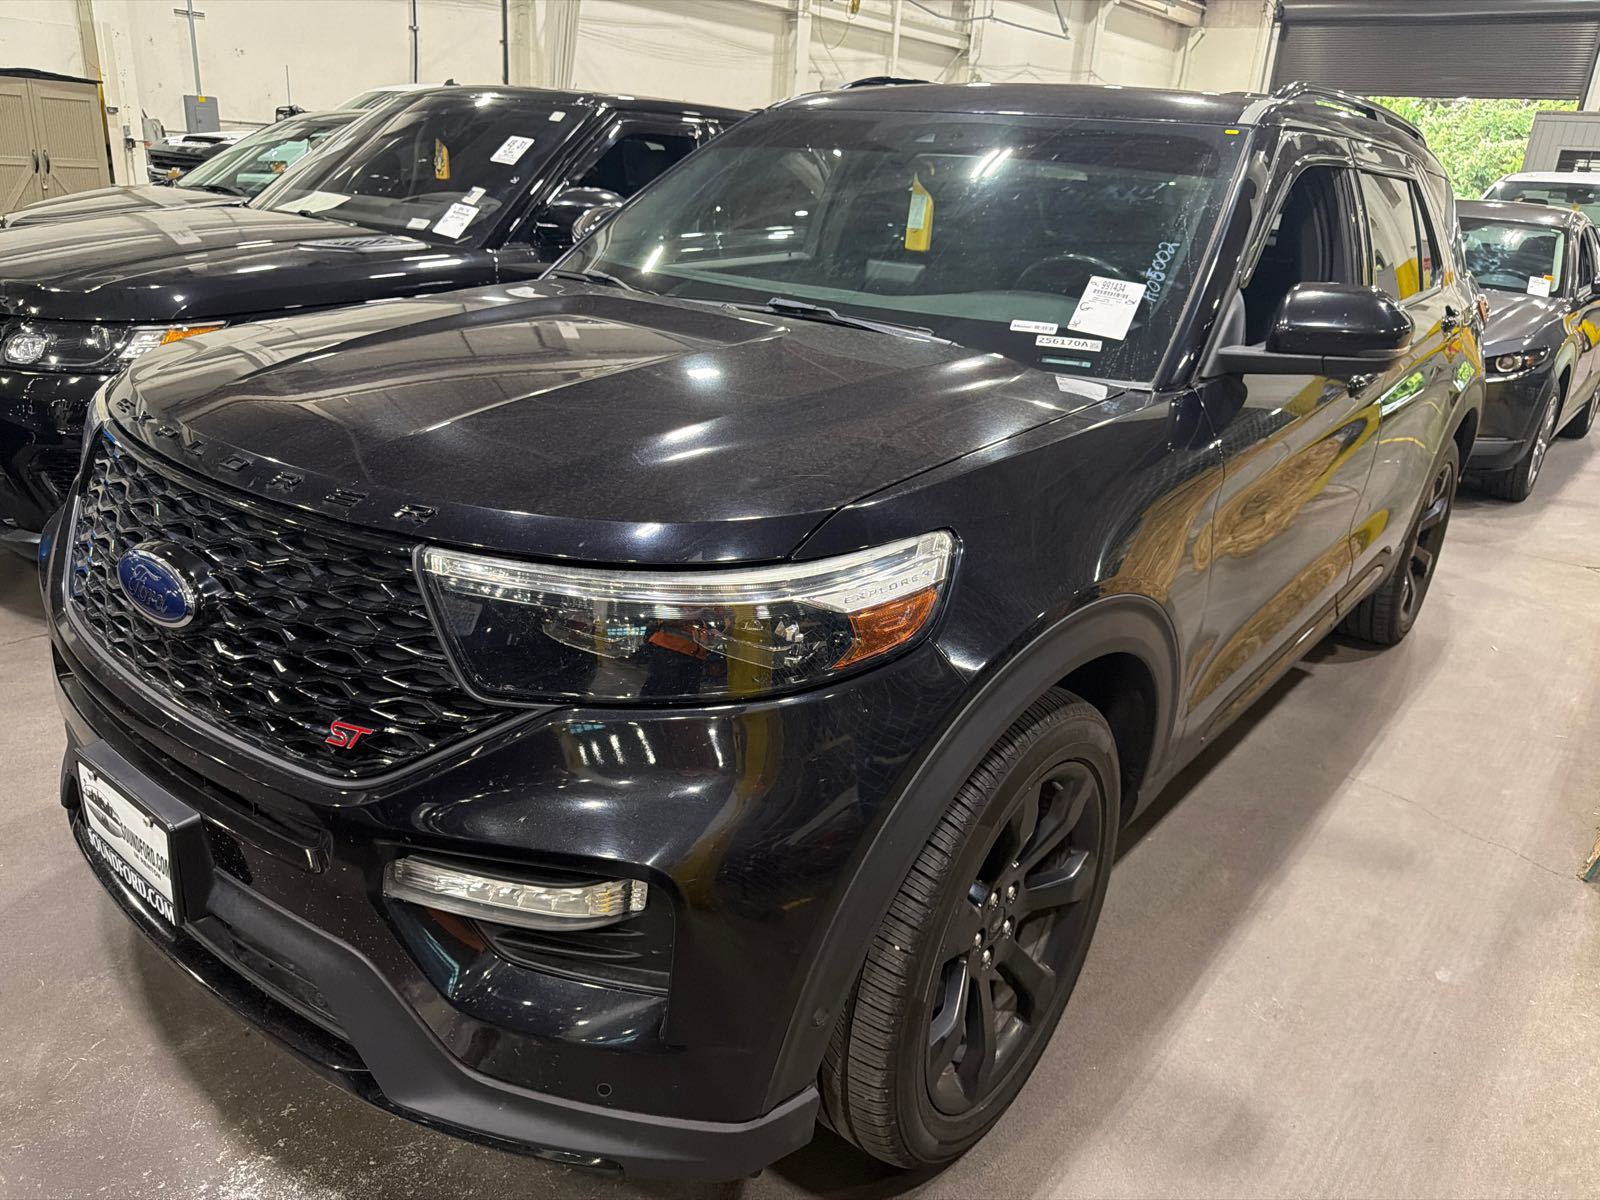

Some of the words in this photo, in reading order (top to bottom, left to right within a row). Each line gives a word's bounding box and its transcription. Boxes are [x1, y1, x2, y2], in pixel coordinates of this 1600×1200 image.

[1038, 337, 1089, 348] 256170A
[116, 398, 438, 525] EXPLORER
[129, 564, 168, 614] Ford
[325, 720, 374, 749] ST
[88, 827, 176, 926] SOUNDFORD.COM
